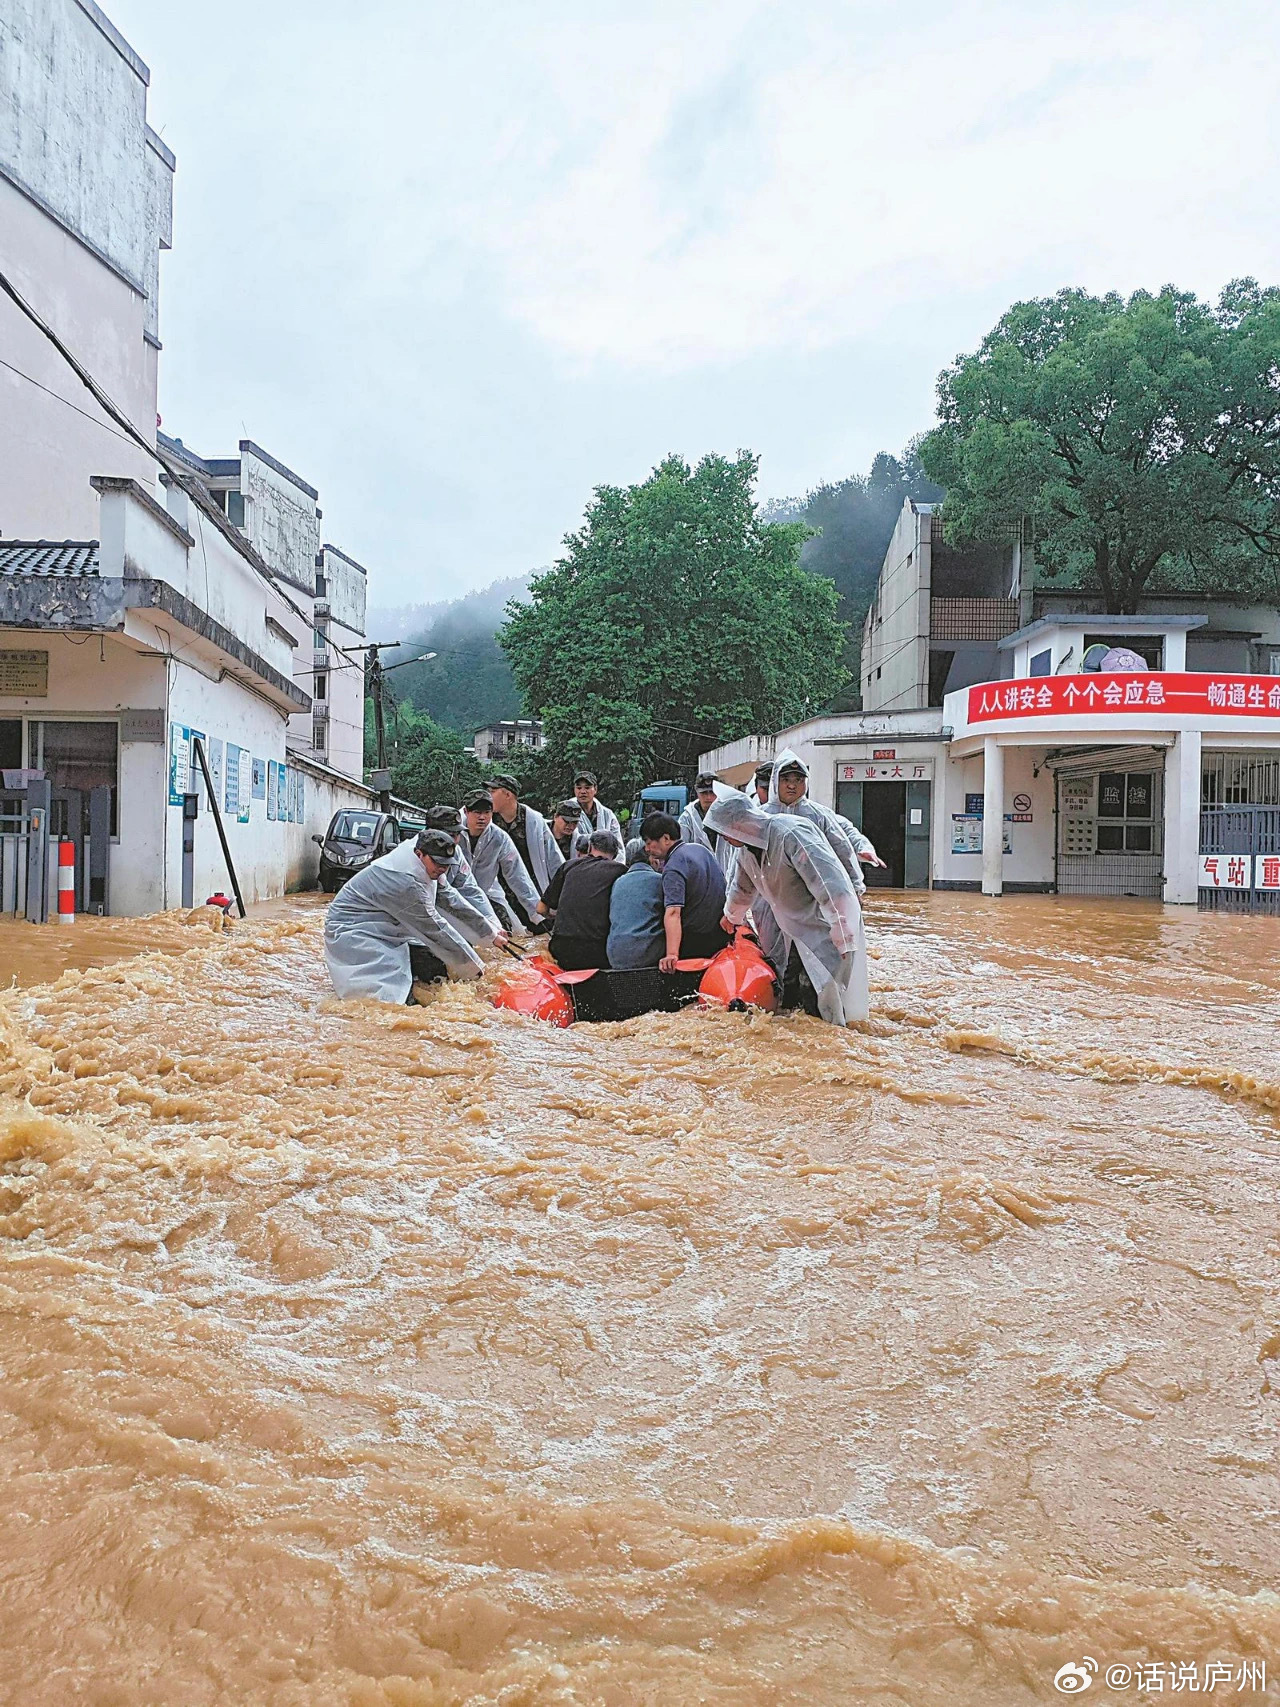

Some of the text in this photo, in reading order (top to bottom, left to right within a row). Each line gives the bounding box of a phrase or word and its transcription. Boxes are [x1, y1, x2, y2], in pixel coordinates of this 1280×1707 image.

[978, 685, 1054, 714] 人人讲安全
[843, 765, 926, 779] 营业大厅
[1103, 786, 1147, 804] 监控
[1203, 856, 1280, 886] 气站 重
